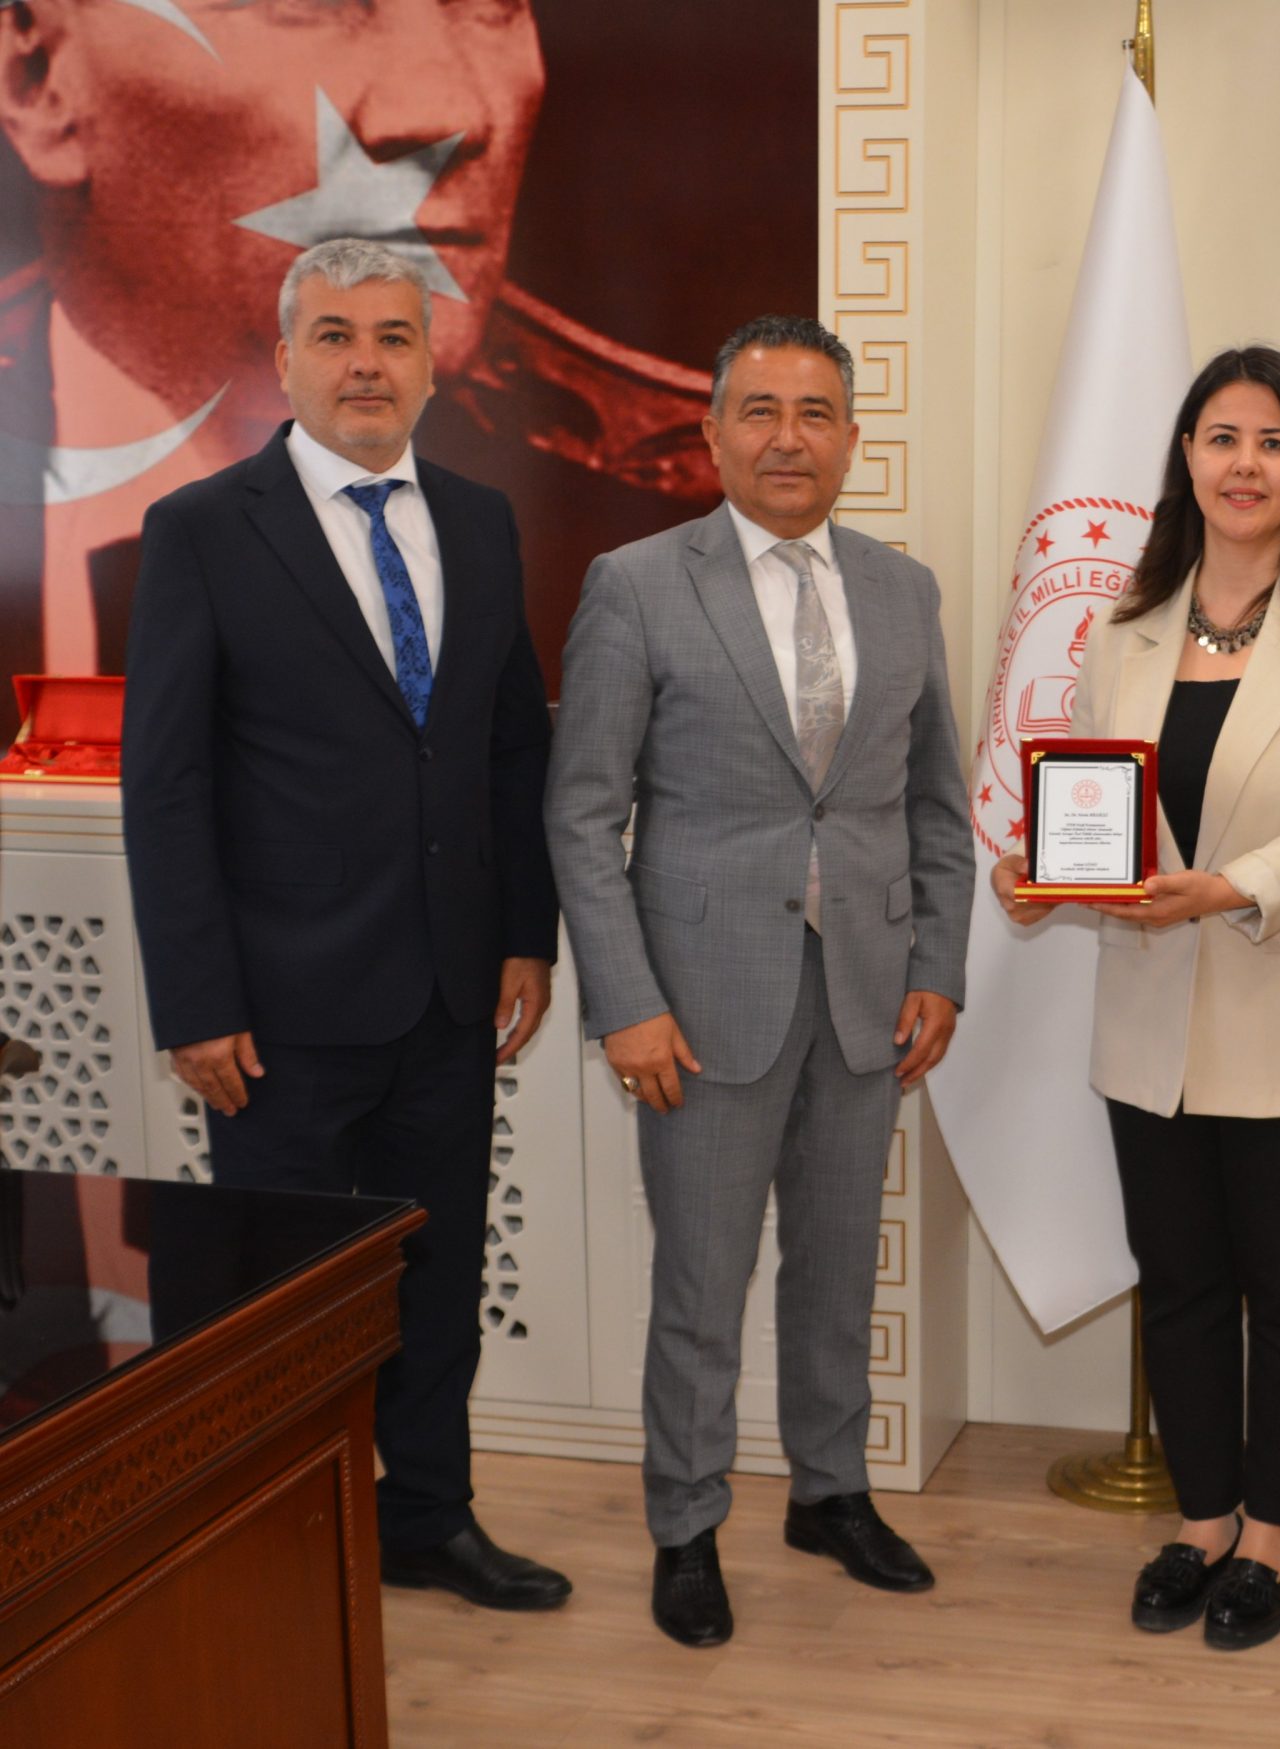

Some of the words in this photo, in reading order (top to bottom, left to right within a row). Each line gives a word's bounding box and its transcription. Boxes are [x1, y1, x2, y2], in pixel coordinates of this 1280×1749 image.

[993, 627, 1018, 748] KIRIKKALE
[1014, 607, 1031, 624] İL
[1030, 566, 1081, 606] MİLLİ
[1089, 570, 1131, 593] EĞİ
